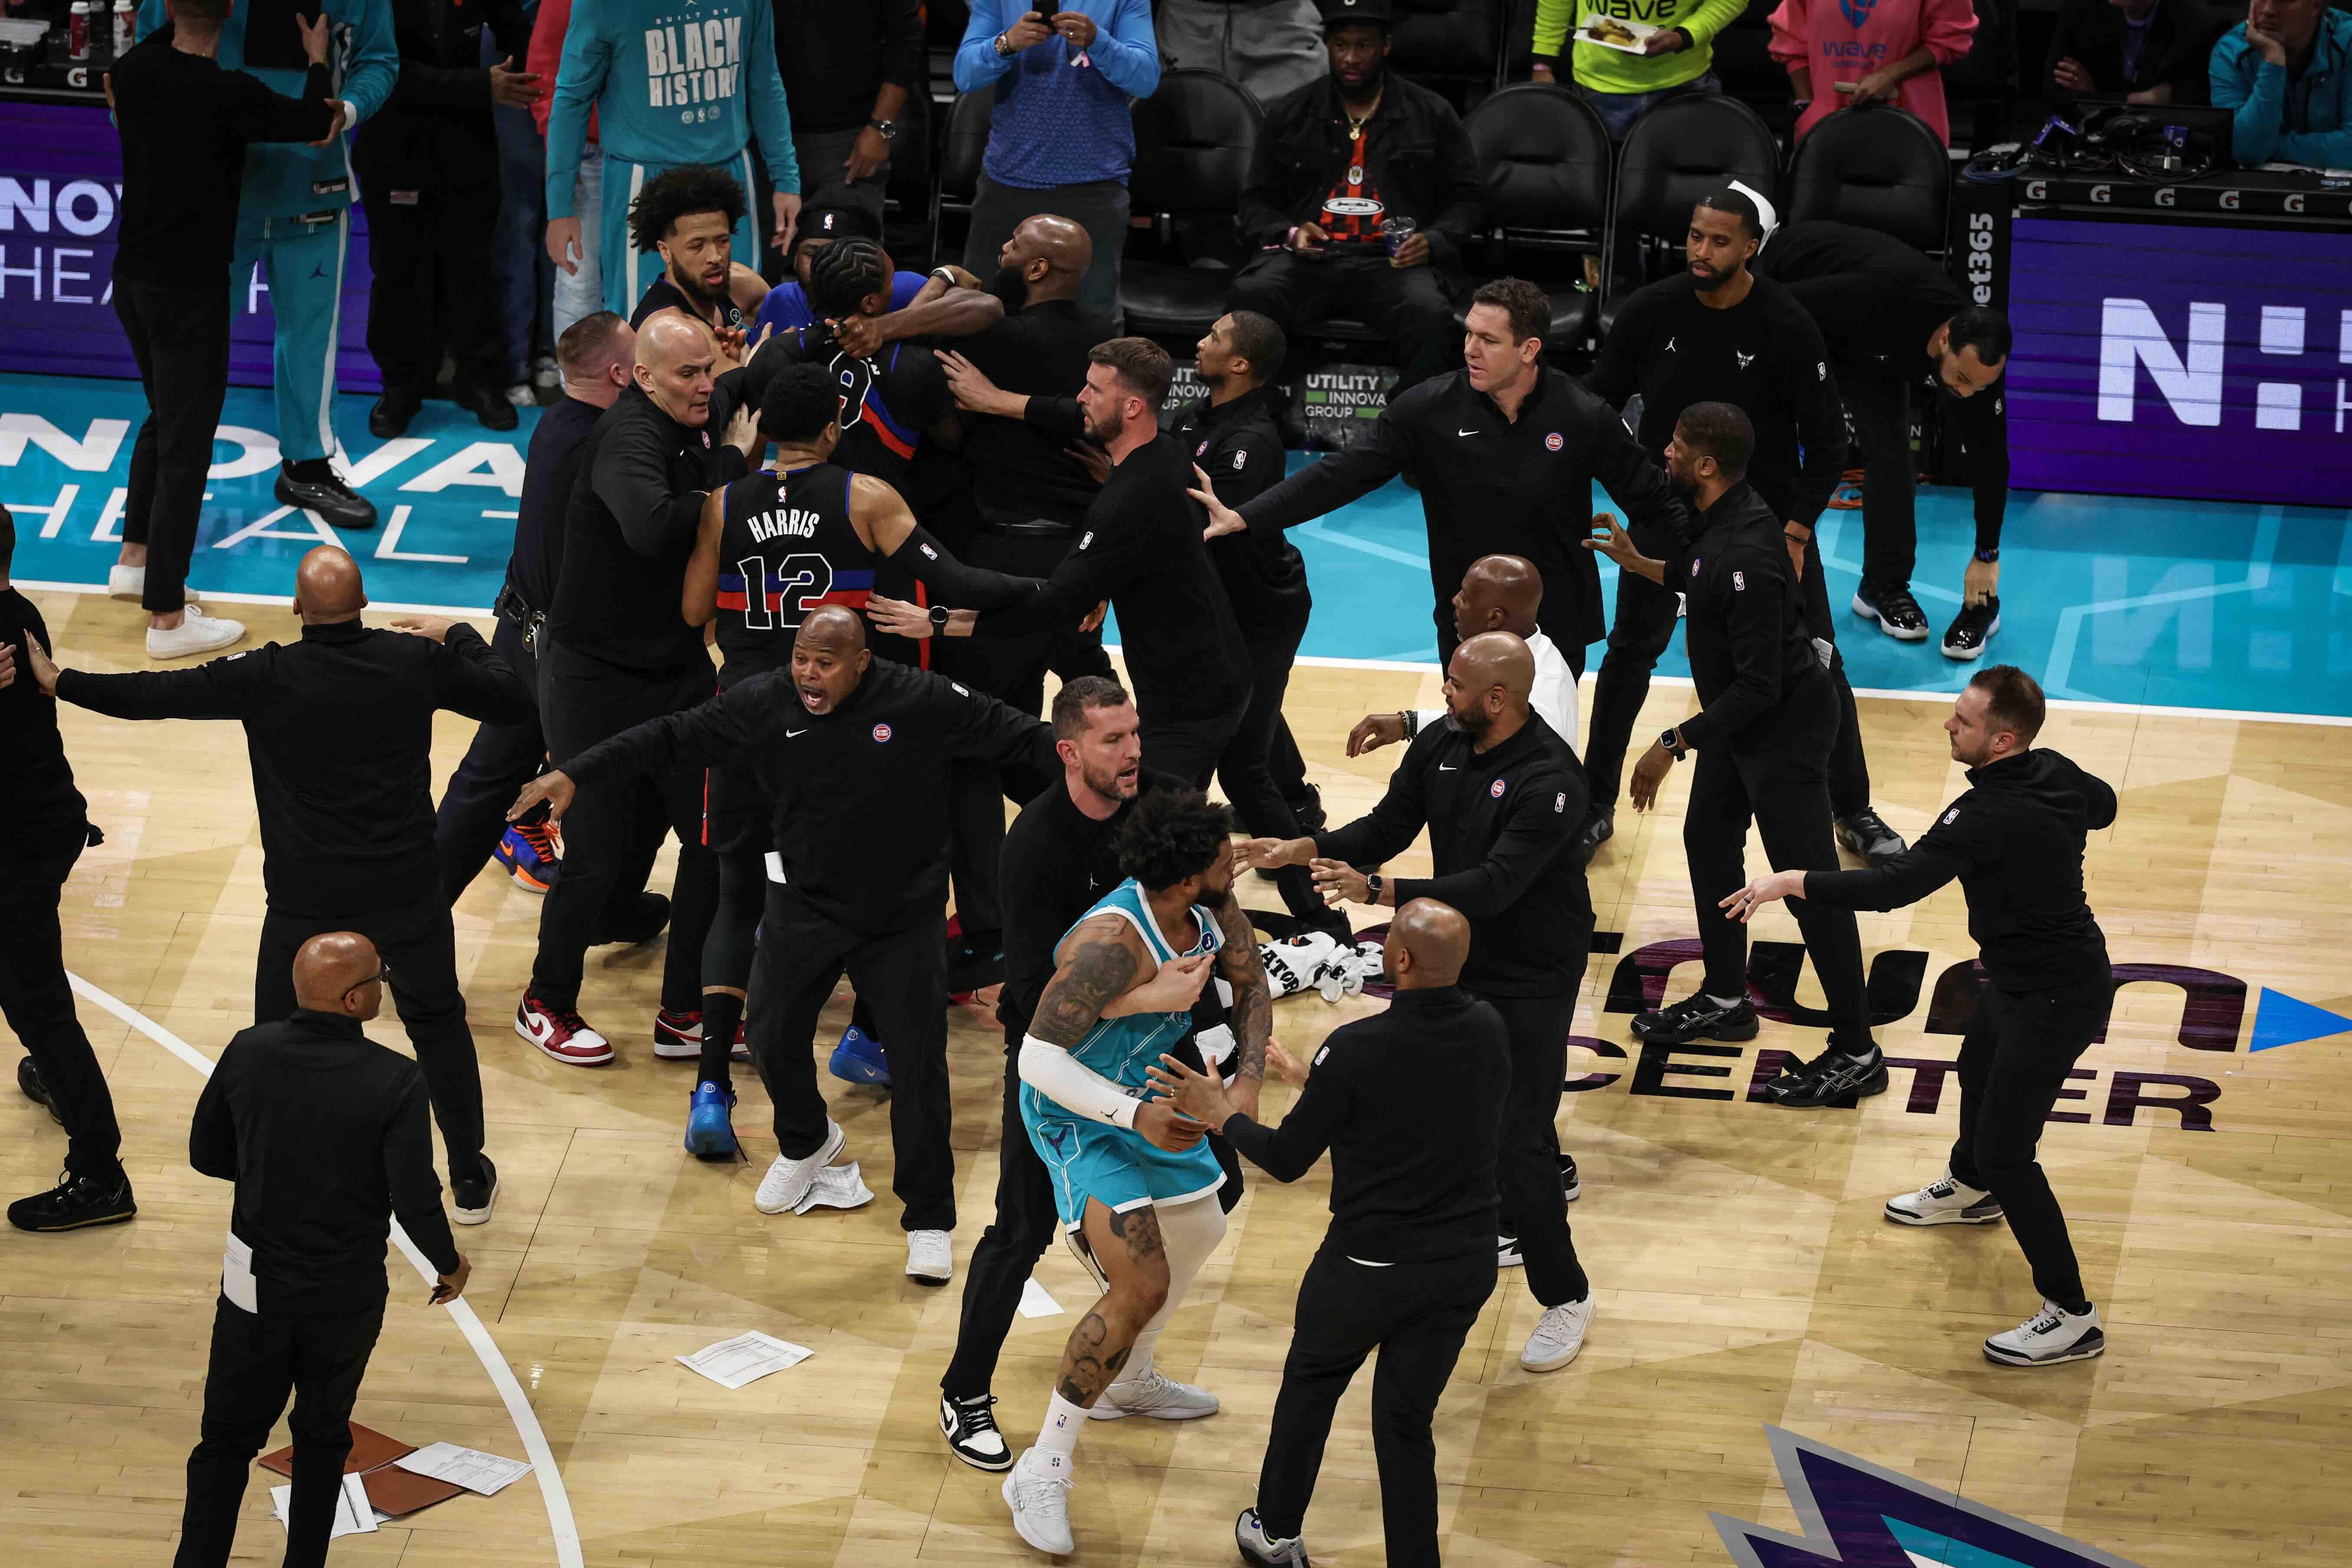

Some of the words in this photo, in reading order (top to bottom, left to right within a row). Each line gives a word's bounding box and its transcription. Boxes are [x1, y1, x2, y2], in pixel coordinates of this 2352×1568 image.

[645, 17, 742, 76] BLACK
[649, 63, 739, 106] HISTORY
[0, 176, 123, 236] NO
[1968, 213, 1993, 307] et365
[1306, 373, 1379, 390] UTILITY
[1305, 406, 1353, 418] GROUP
[747, 509, 820, 543] HARRIS
[737, 553, 833, 630] 12
